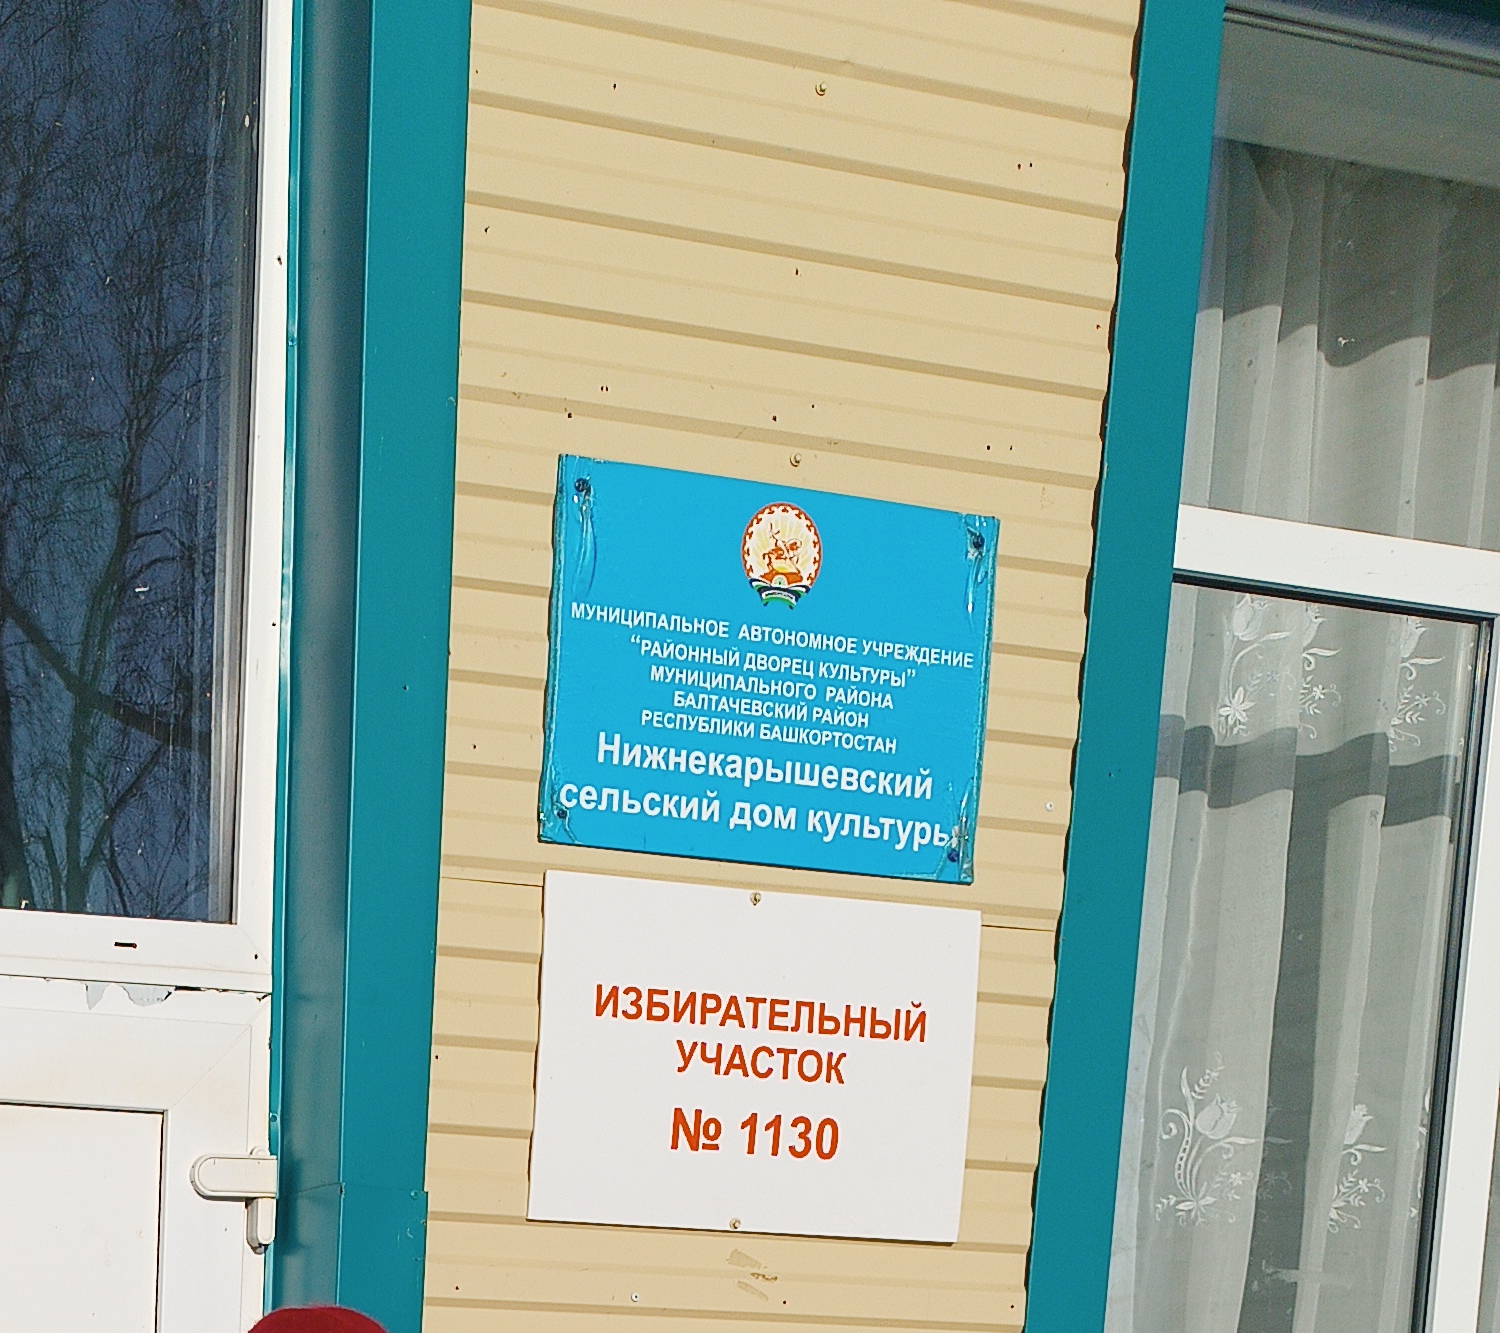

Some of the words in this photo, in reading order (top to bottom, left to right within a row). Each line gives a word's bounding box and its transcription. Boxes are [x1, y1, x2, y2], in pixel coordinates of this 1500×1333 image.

[570, 601, 730, 639] МУНИЦИПАЛЬНОЕ
[737, 623, 858, 655] АВТОНОМНОЕ
[862, 639, 975, 670] УЧРЕЖДЕНИЕ
[630, 634, 741, 668] “РАЙОННЫЙ
[742, 652, 815, 679] ДВОРЕЦ
[818, 660, 917, 689] КУЛЬТУРЫ”
[650, 664, 817, 701] МУНИЦИПАЛЬНОГО
[825, 684, 895, 711] РАЙОНА
[673, 690, 808, 722] БАЛТАЧЕВСКИЙ
[812, 704, 870, 729] РАЙОН
[641, 709, 756, 740] РЕСПУБЛИКИ
[759, 722, 898, 755] БАШКОРТОСТАН
[597, 731, 934, 800] Нижнекарышевский
[558, 782, 721, 824] сельский
[729, 801, 798, 833] дом
[594, 983, 928, 1043] ИЗБИРАТЕЛЬНЫЙ
[675, 1038, 847, 1085] УЧАСТОК
[670, 1107, 723, 1153] №
[740, 1111, 840, 1161] 1130
